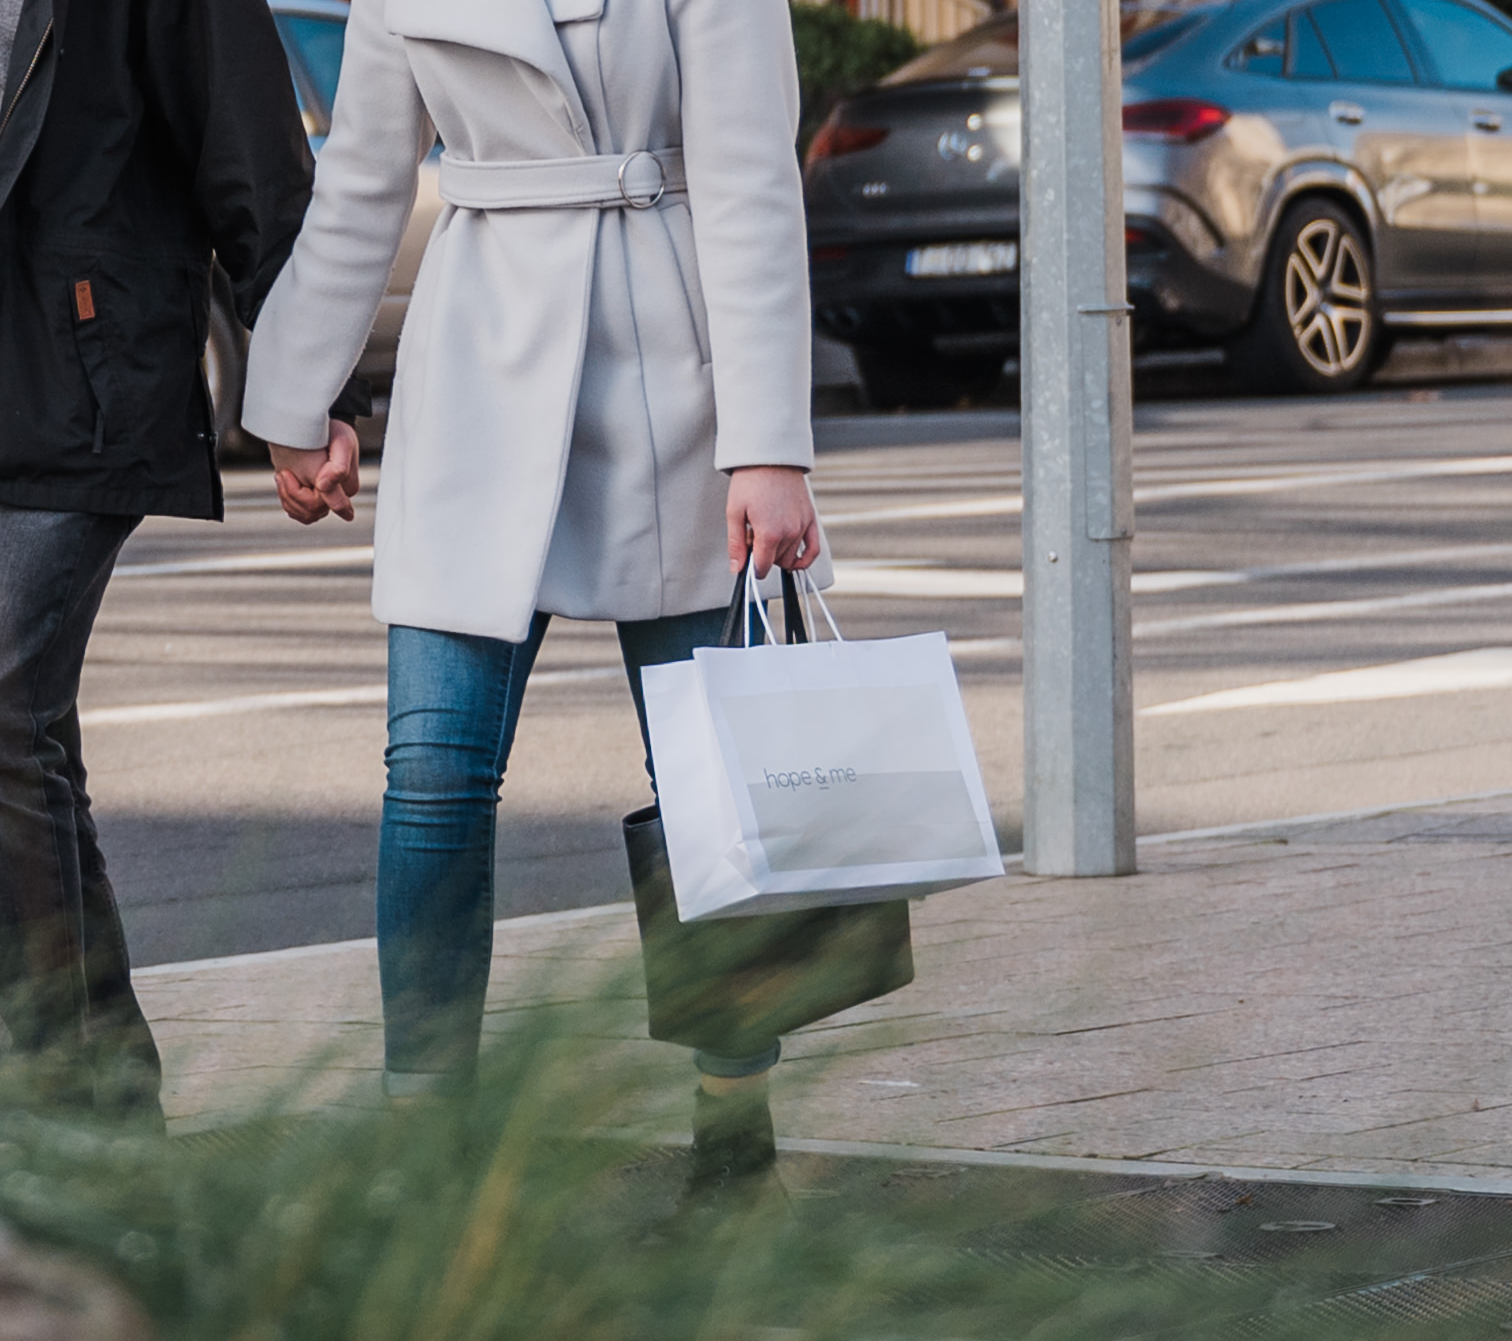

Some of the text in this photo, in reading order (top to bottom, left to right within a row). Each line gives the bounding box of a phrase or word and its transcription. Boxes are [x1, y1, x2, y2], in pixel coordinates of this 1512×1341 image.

[763, 767, 856, 792] hope & me
